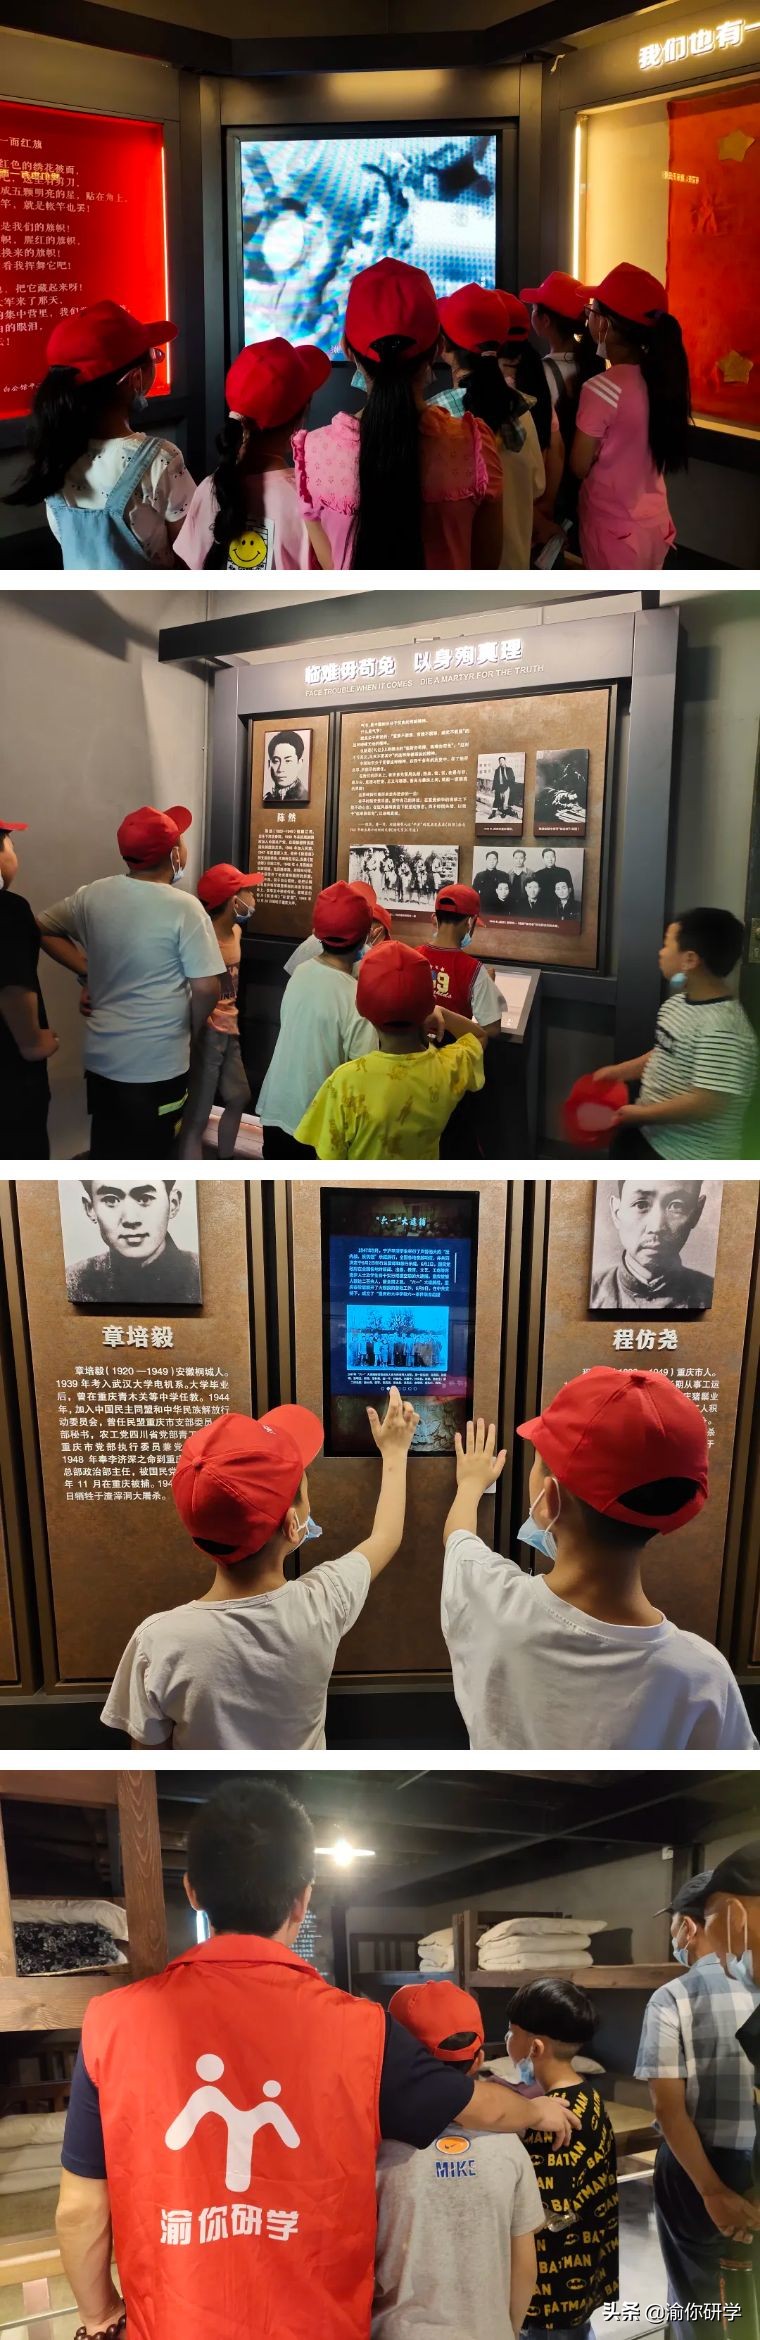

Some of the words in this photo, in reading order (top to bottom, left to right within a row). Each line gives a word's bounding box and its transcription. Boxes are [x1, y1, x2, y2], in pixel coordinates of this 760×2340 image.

[639, 20, 760, 69] 我们也有一
[0, 296, 63, 307] 军来了那天,
[304, 656, 396, 685] 临难毋苟免
[414, 638, 522, 673] 以身殉真理
[324, 686, 355, 697] TROUBLE
[357, 684, 377, 692] WHEN
[386, 680, 413, 689] COMES
[420, 678, 433, 686] DIE
[441, 672, 475, 683] MARTYR
[476, 670, 494, 680] FOR
[496, 668, 512, 677] THE
[514, 664, 544, 675] TRUTH
[102, 1325, 174, 1348] 章培毅
[613, 1328, 678, 1350] 程仿尧
[671, 1380, 720, 1389] 期从事工运
[435, 2160, 476, 2178] MIKE
[160, 2203, 299, 2246] 渝你研学
